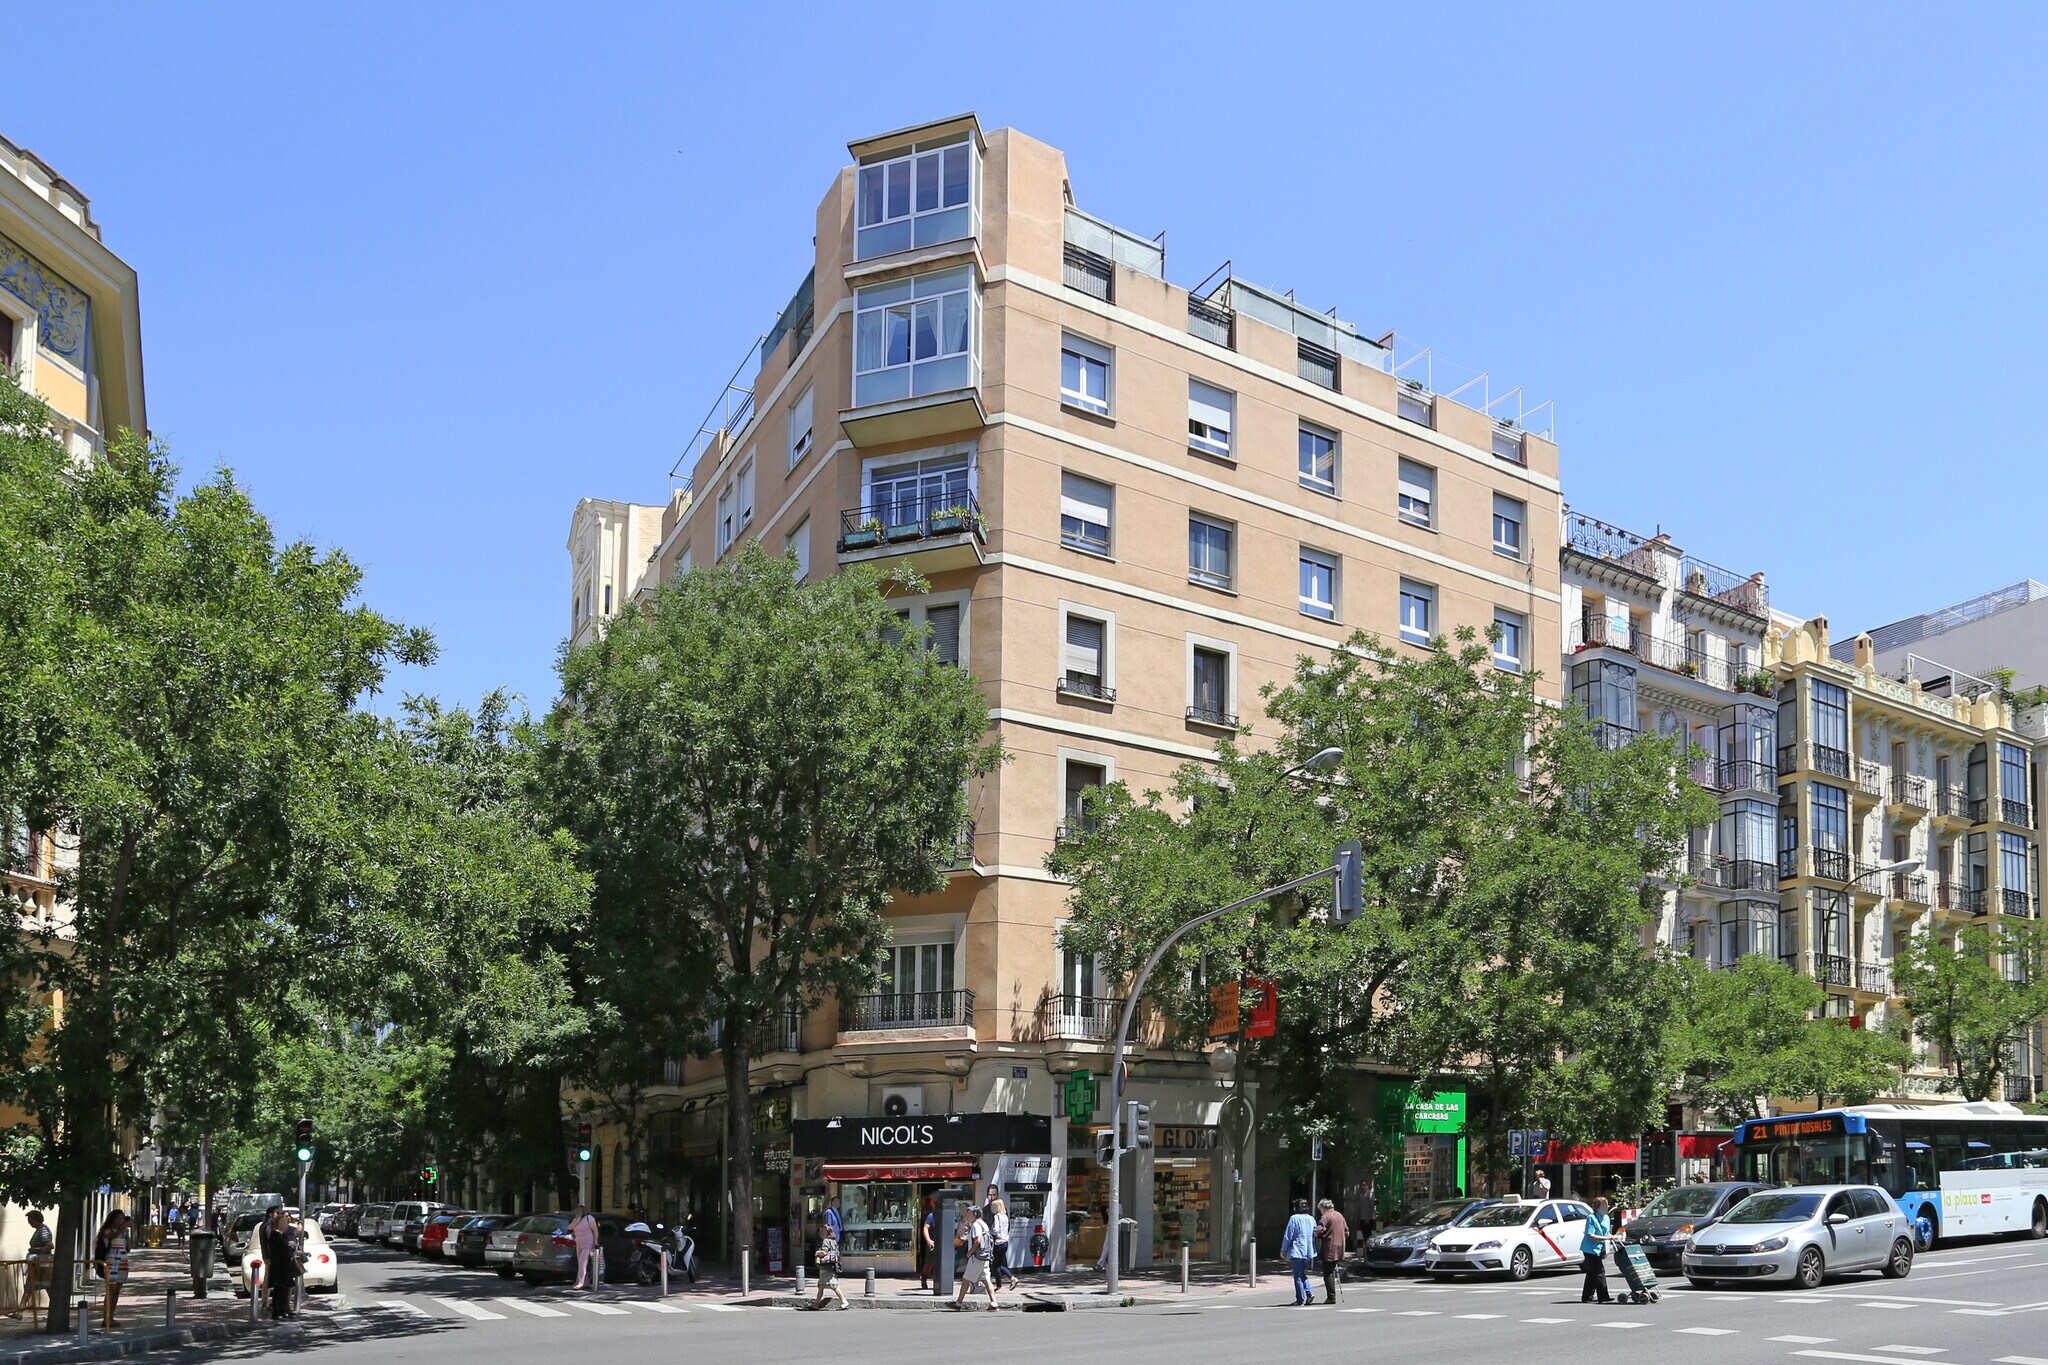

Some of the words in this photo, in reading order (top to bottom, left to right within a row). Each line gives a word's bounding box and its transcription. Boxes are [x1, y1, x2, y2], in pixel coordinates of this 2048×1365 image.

[1416, 1103, 1433, 1111] CASA
[1435, 1103, 1444, 1111] DE
[1446, 1103, 1459, 1111] LAS
[1414, 1112, 1449, 1120] CARCASAS
[1753, 1125, 1768, 1139] 21
[1774, 1123, 1800, 1136] PINTOR
[1801, 1120, 1832, 1134] ROSALES
[861, 1124, 934, 1146] NICOL'S
[1163, 1129, 1218, 1150] GLOBO
[764, 1150, 791, 1160] FRUTOS
[766, 1161, 789, 1170] SECOS
[892, 1168, 927, 1178] NICOL'S
[1943, 1189, 1952, 1207] la
[1955, 1189, 1978, 1211] plaza
